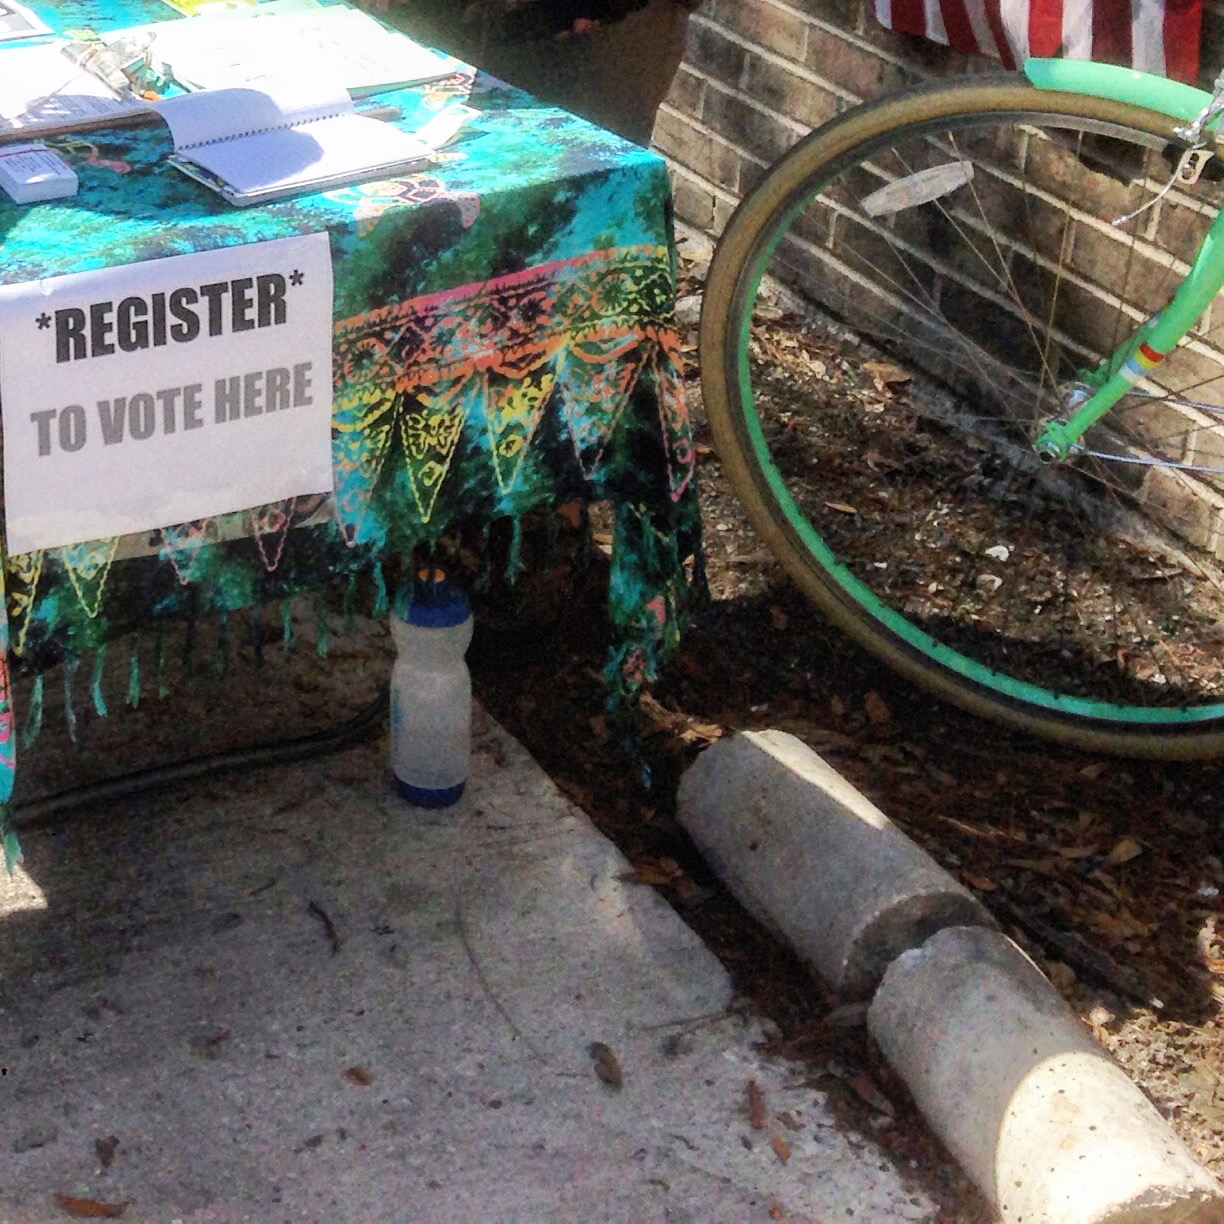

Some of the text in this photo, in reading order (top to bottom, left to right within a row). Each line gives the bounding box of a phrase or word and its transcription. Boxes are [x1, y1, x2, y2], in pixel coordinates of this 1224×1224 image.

[30, 361, 314, 458] TO VOTE HERE
